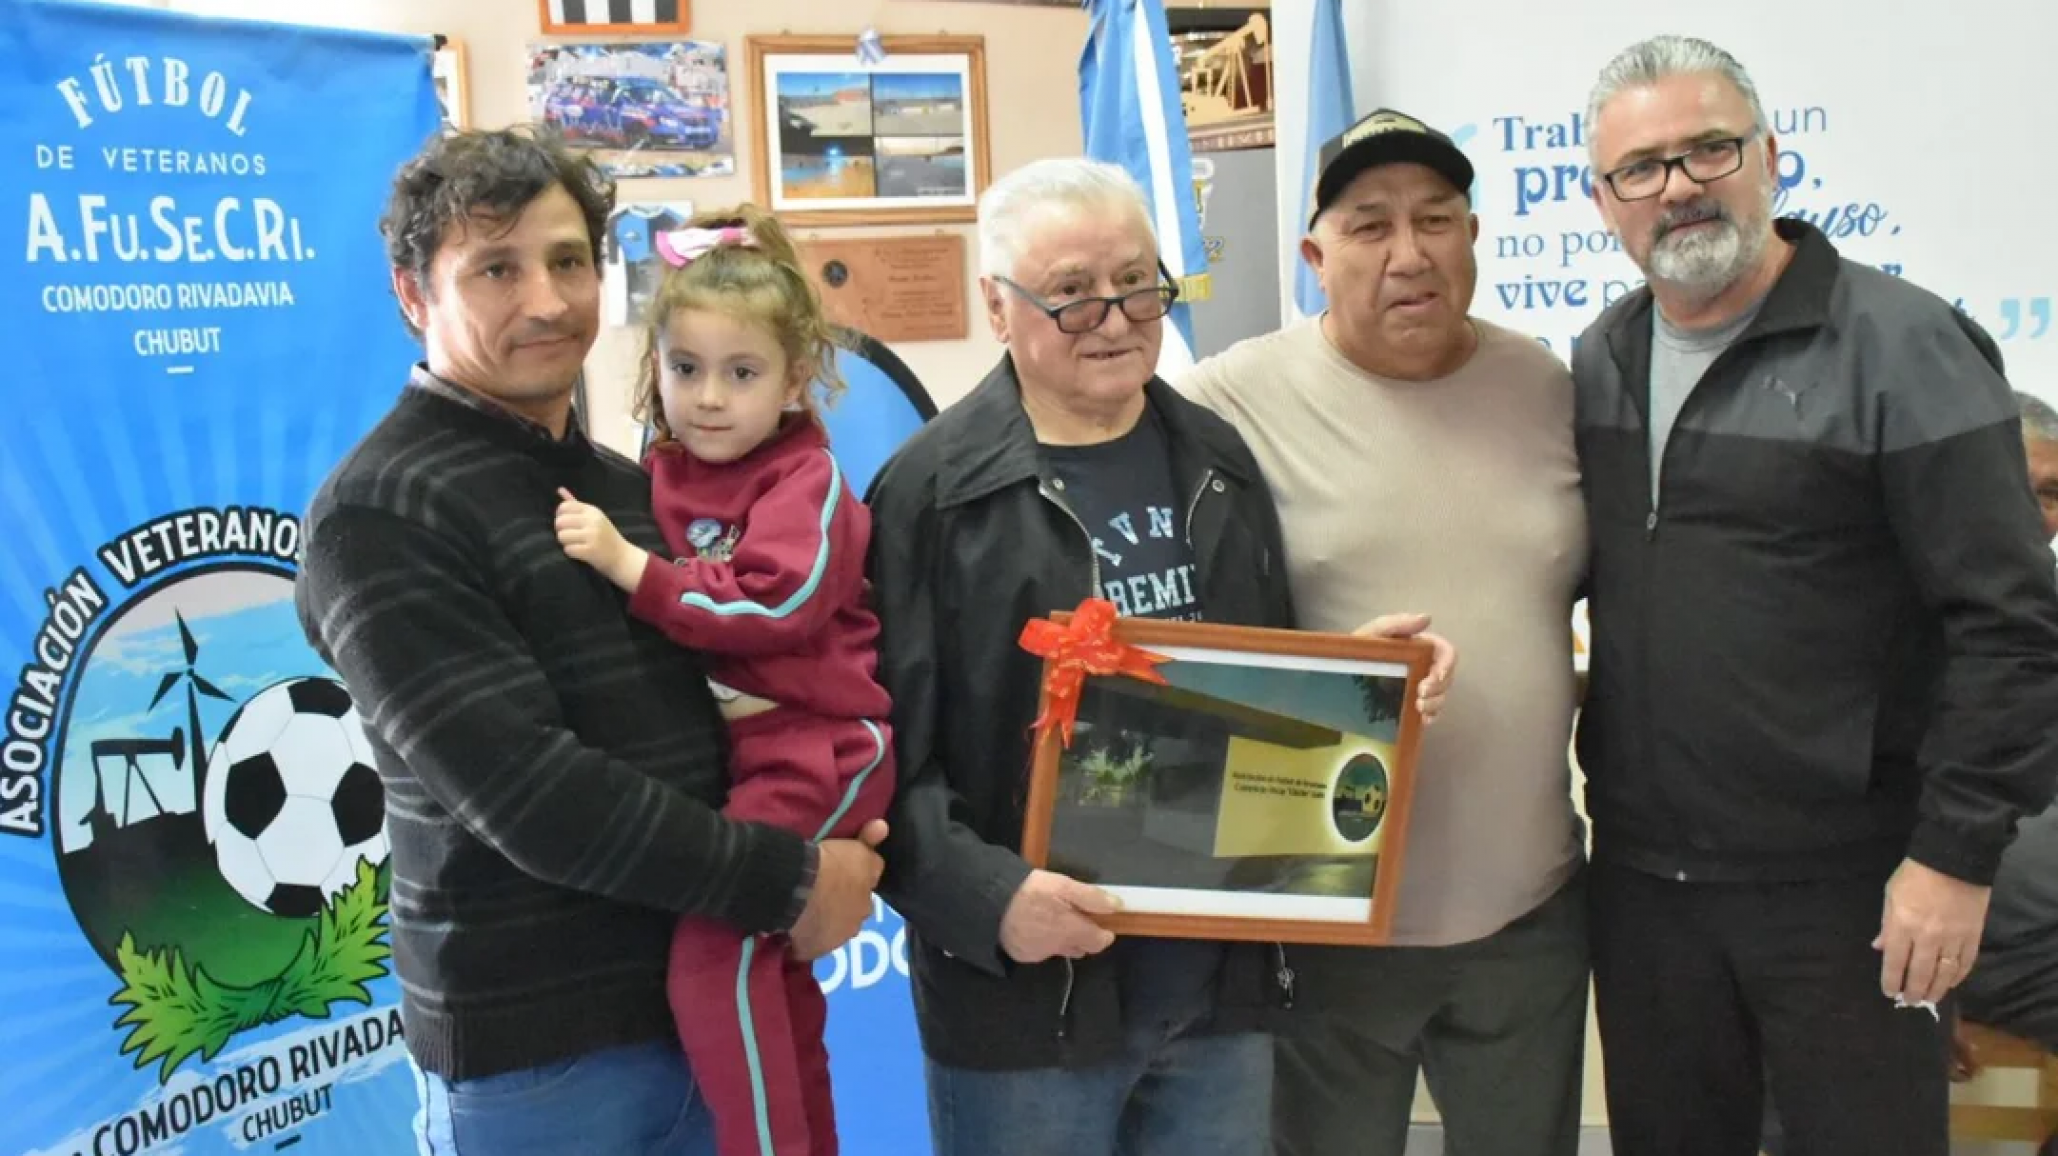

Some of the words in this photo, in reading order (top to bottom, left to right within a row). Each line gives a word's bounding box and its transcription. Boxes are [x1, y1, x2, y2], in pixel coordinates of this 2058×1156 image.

[57, 53, 252, 137] FÚTBOL
[1774, 106, 1827, 134] un
[36, 145, 75, 169] DE
[102, 148, 267, 176] VETERANOS
[1496, 233, 1545, 259] no
[42, 284, 173, 313] COMODORO
[178, 281, 294, 309] RIVADAVIA
[1495, 274, 1589, 310] vive
[134, 327, 222, 356] CHUBUT
[1104, 563, 1197, 618] REMI
[0, 571, 105, 834] ASOCIACIÓN
[103, 510, 300, 584] VETERANO
[92, 1055, 282, 1156] COMODORO
[288, 1007, 405, 1084] RIVADA
[241, 1083, 334, 1143] CHUBUT
